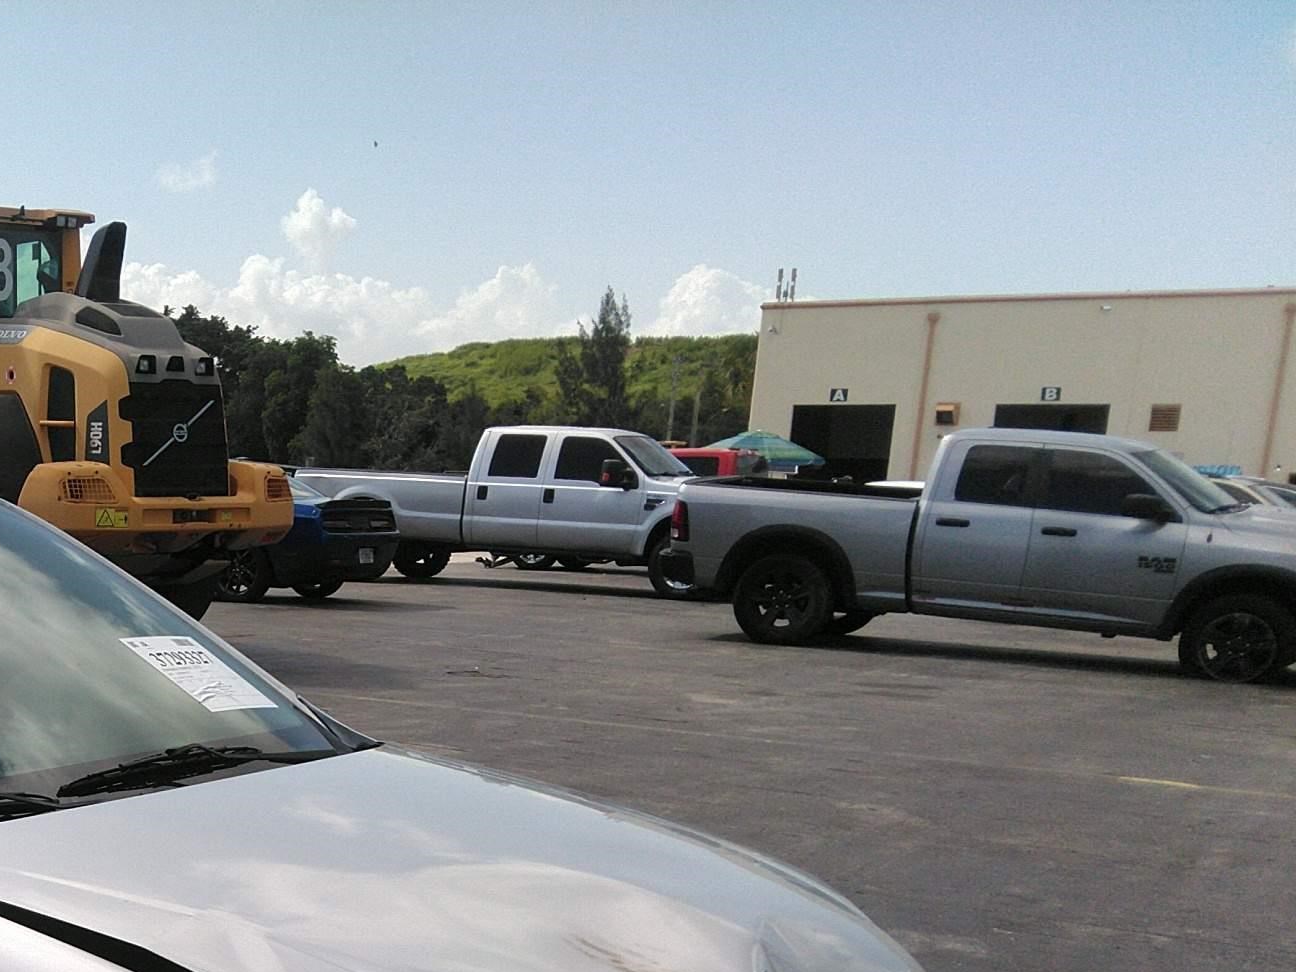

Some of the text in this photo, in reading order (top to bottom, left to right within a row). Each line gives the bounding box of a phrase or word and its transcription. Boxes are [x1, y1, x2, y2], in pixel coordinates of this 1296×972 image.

[832, 389, 845, 401] A
[1044, 388, 1057, 401] B
[89, 421, 103, 454] L90H
